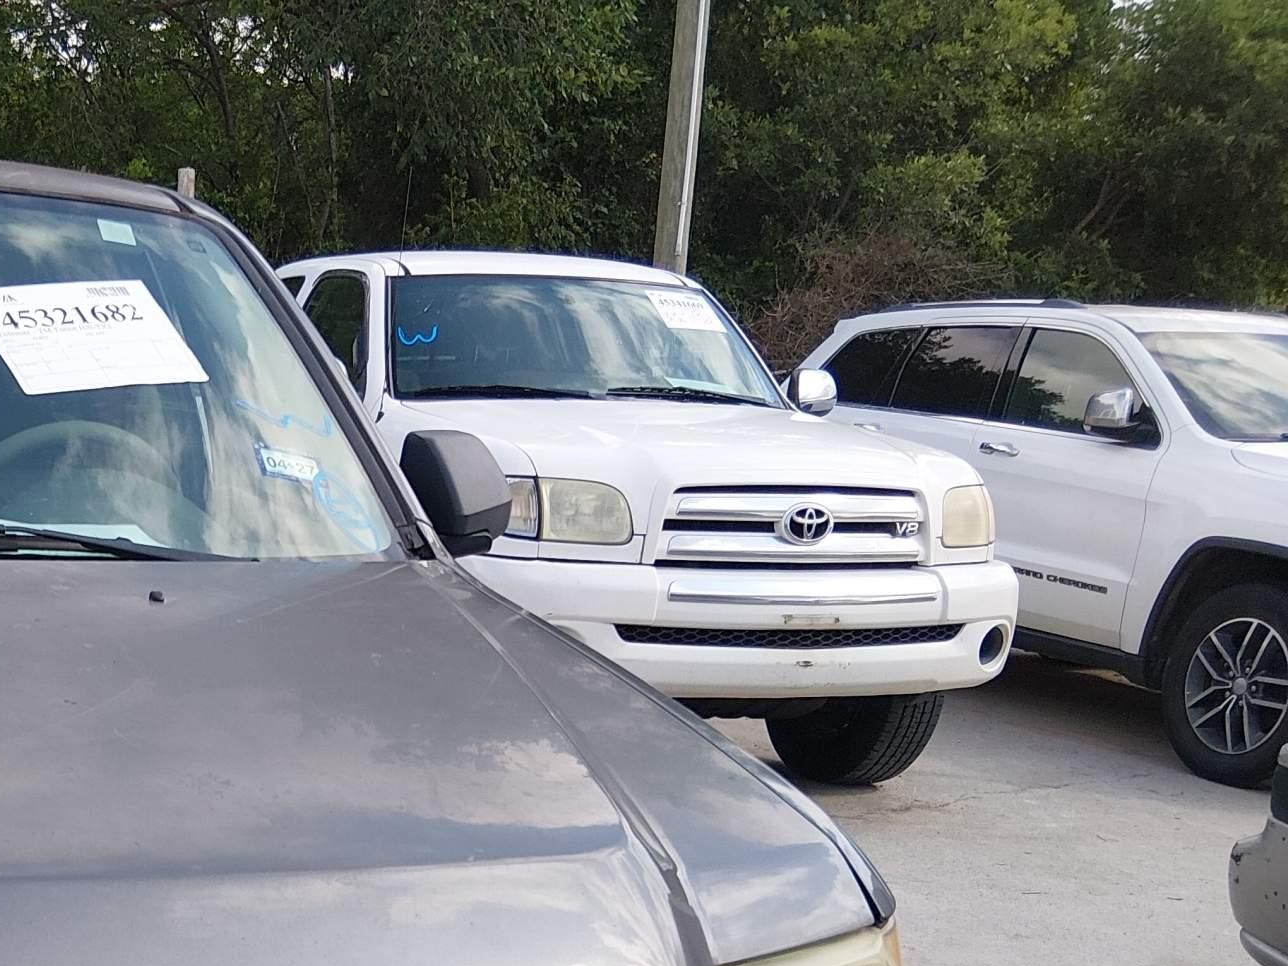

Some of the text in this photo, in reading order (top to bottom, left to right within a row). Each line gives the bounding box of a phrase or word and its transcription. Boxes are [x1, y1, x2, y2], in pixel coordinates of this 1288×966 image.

[2, 304, 144, 329] 45321682
[896, 521, 920, 537] V8
[1046, 574, 1108, 595] CHEROKEE
